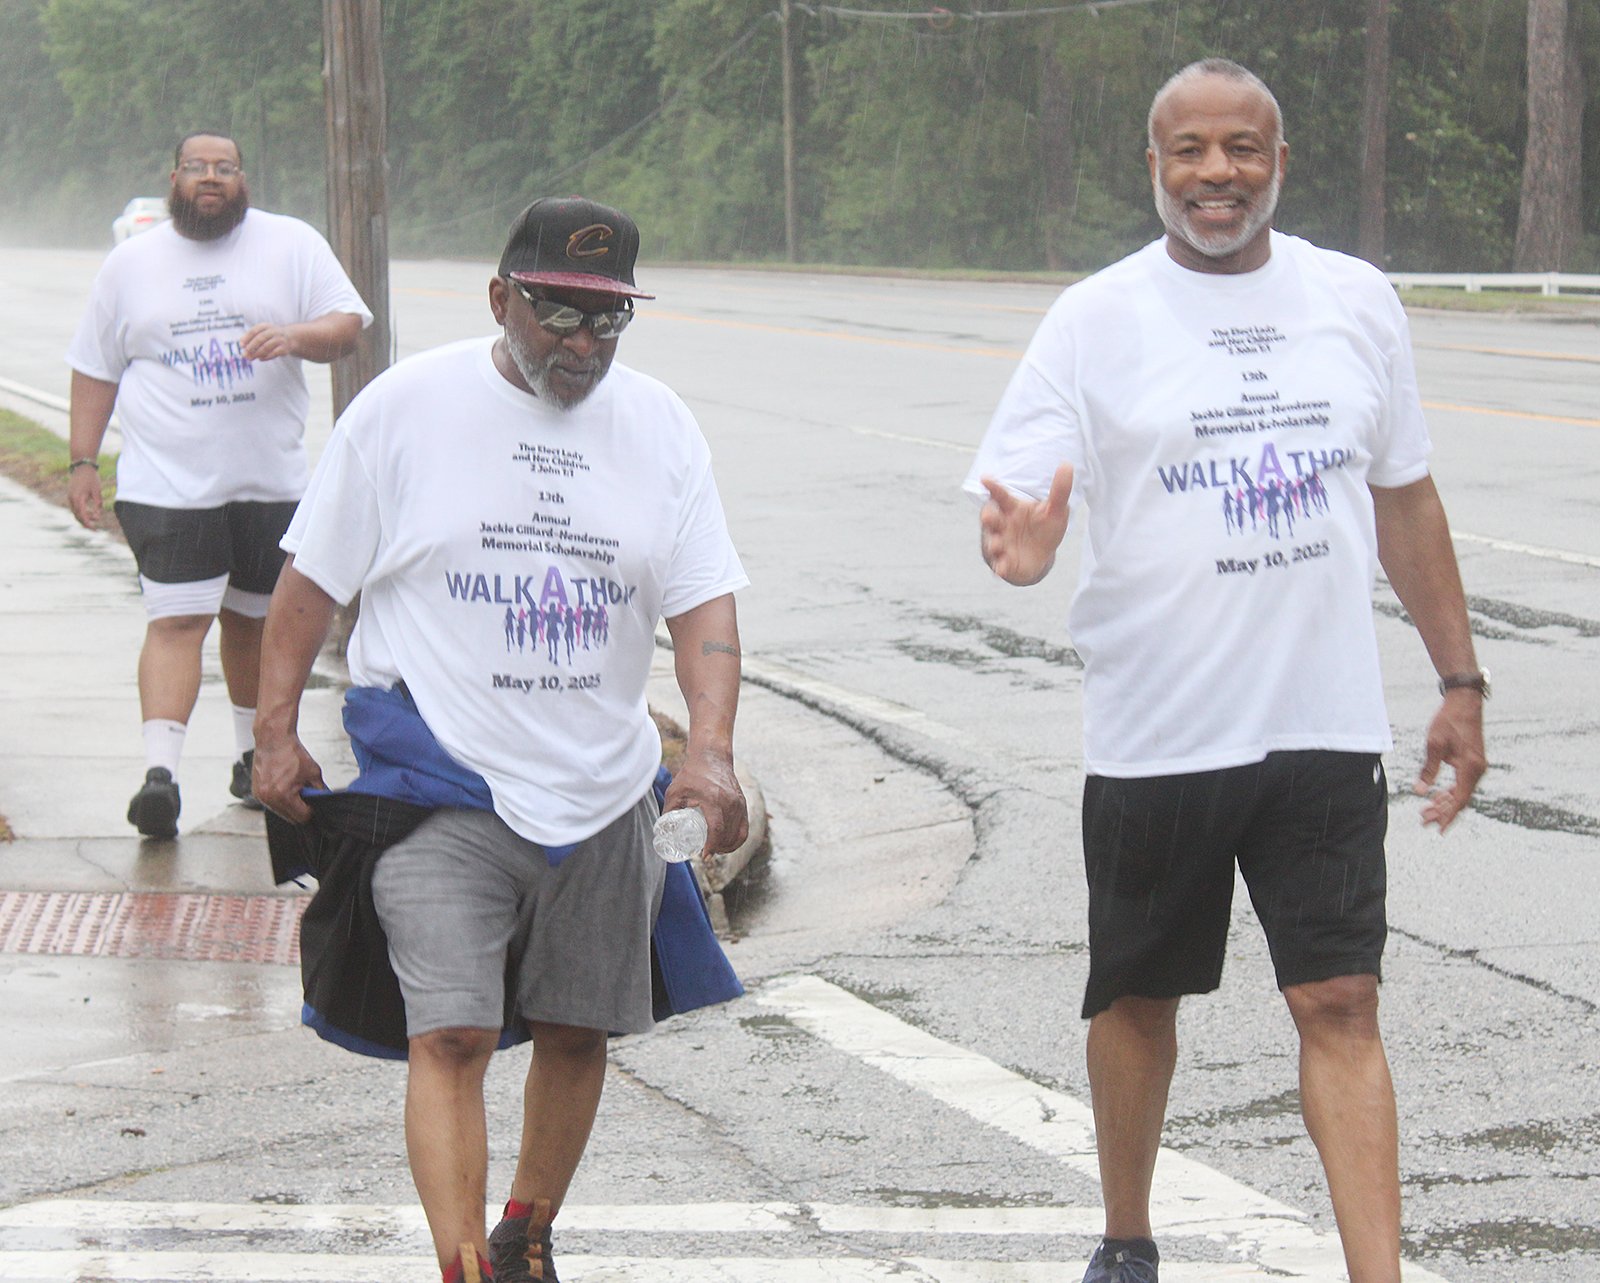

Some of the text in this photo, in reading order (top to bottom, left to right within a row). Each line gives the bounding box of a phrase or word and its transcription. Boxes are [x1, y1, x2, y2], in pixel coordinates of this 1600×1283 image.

[566, 223, 613, 261] C
[191, 398, 213, 407] May
[1241, 391, 1280, 403] Annual
[1194, 414, 1330, 438] Memorial Scholarship
[518, 442, 583, 461] The Elect Lady
[512, 453, 590, 471] and Her Children
[538, 465, 561, 475] John
[538, 491, 565, 504] 13th
[532, 512, 571, 526] Annual
[479, 521, 620, 548] Jackie Gilliard-Henderson
[482, 537, 616, 565] Memorial Scholarship
[1215, 539, 1330, 576] May 10, 2025
[492, 672, 601, 694] May 10, 2025
